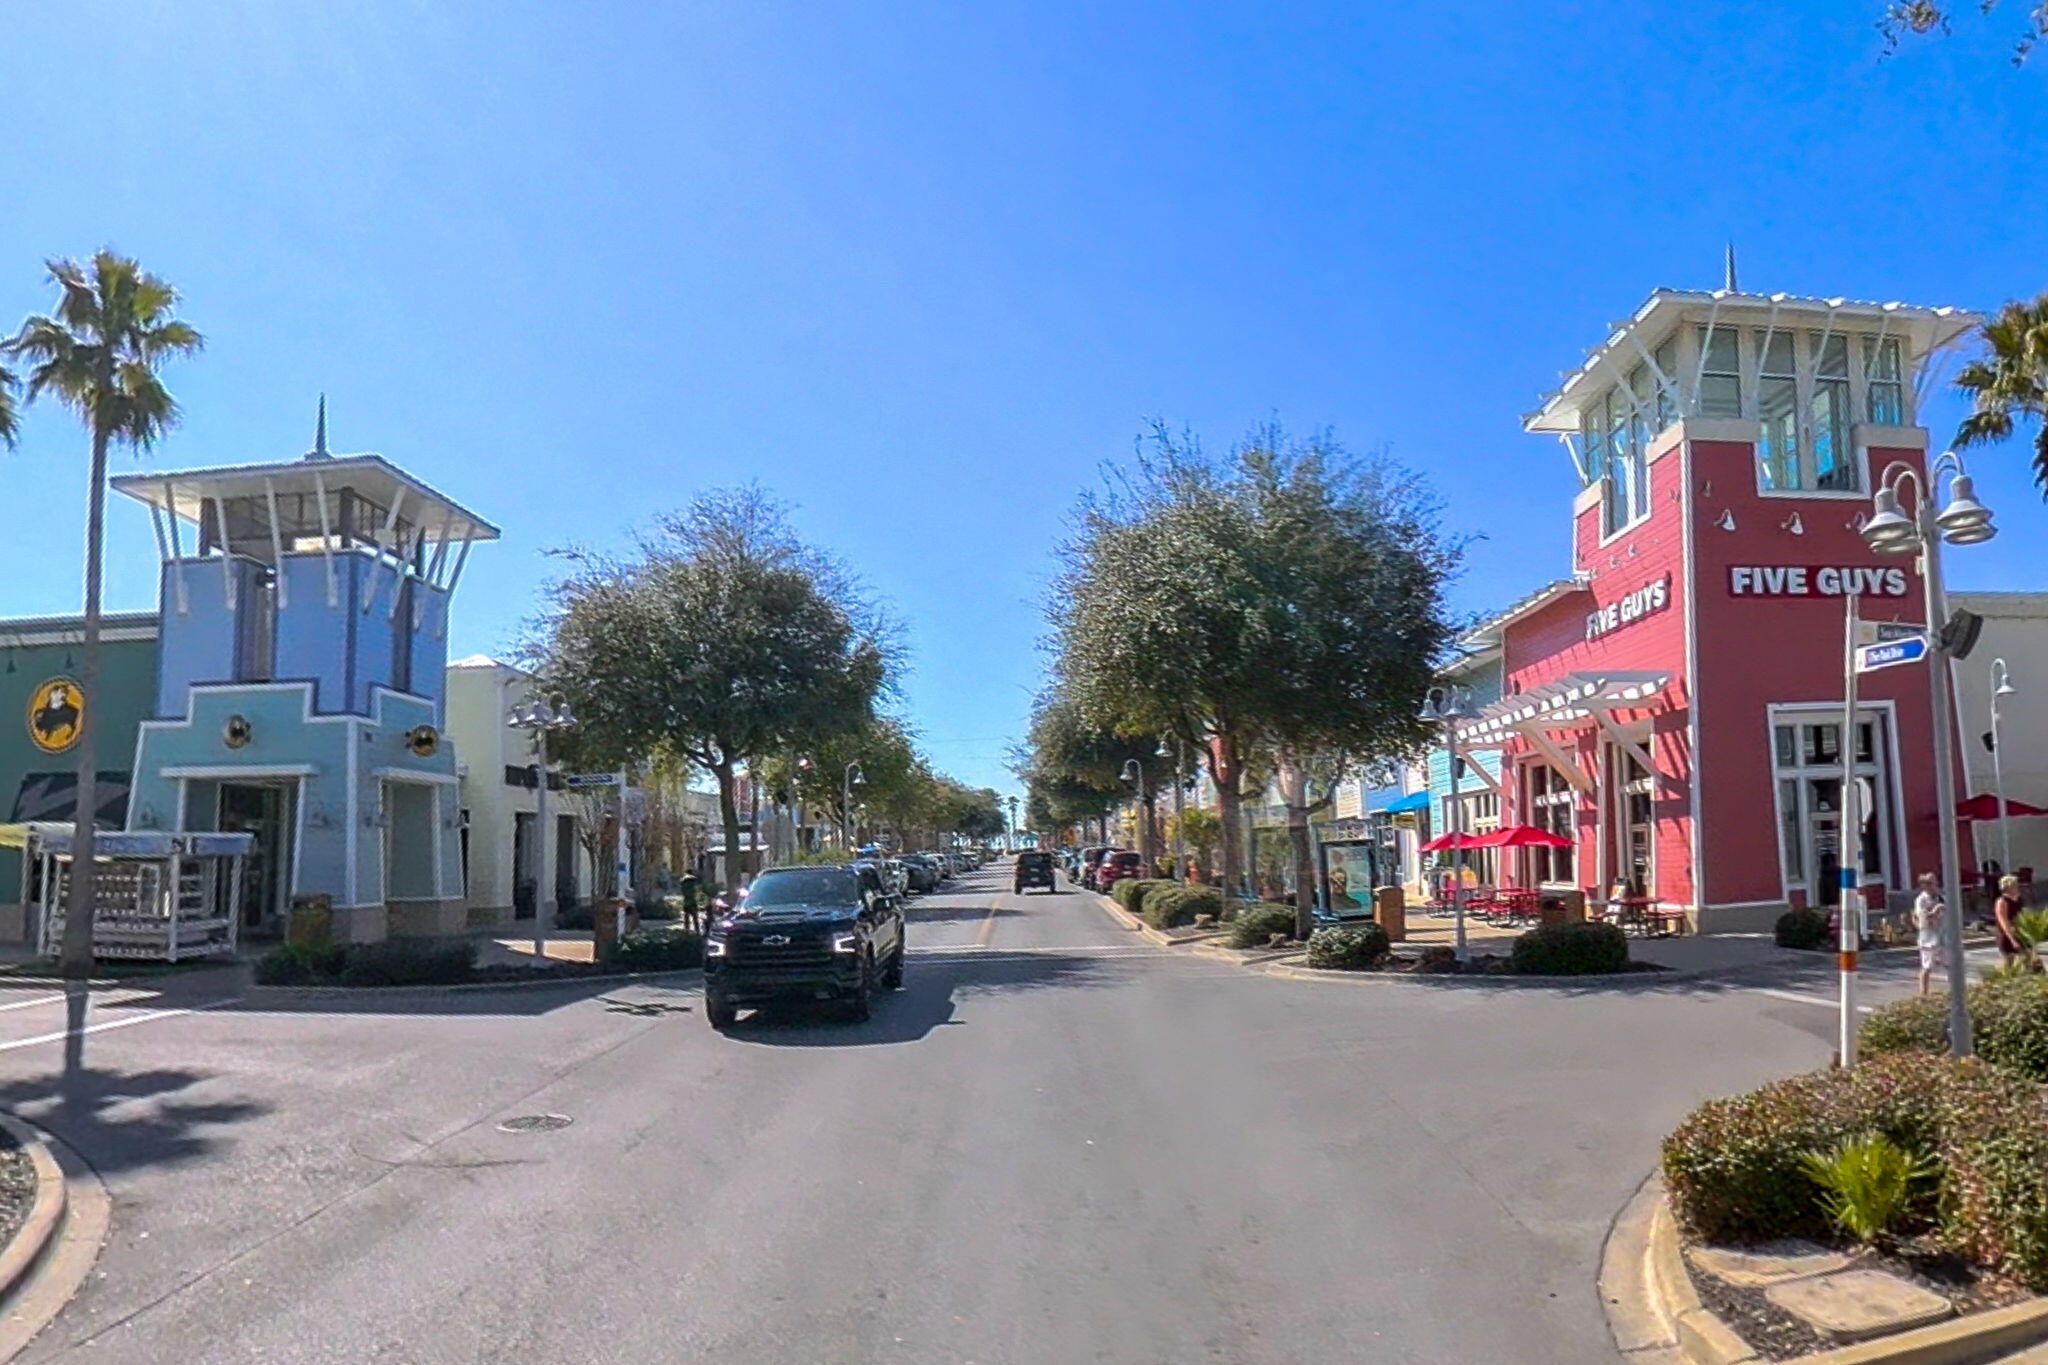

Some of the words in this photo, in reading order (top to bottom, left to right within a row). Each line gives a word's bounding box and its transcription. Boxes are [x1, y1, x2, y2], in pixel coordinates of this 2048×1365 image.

[1731, 567, 1809, 594] FIVE
[1816, 567, 1907, 596] GUYS
[1585, 602, 1619, 640] FIVE
[1620, 578, 1666, 623] GUYS
